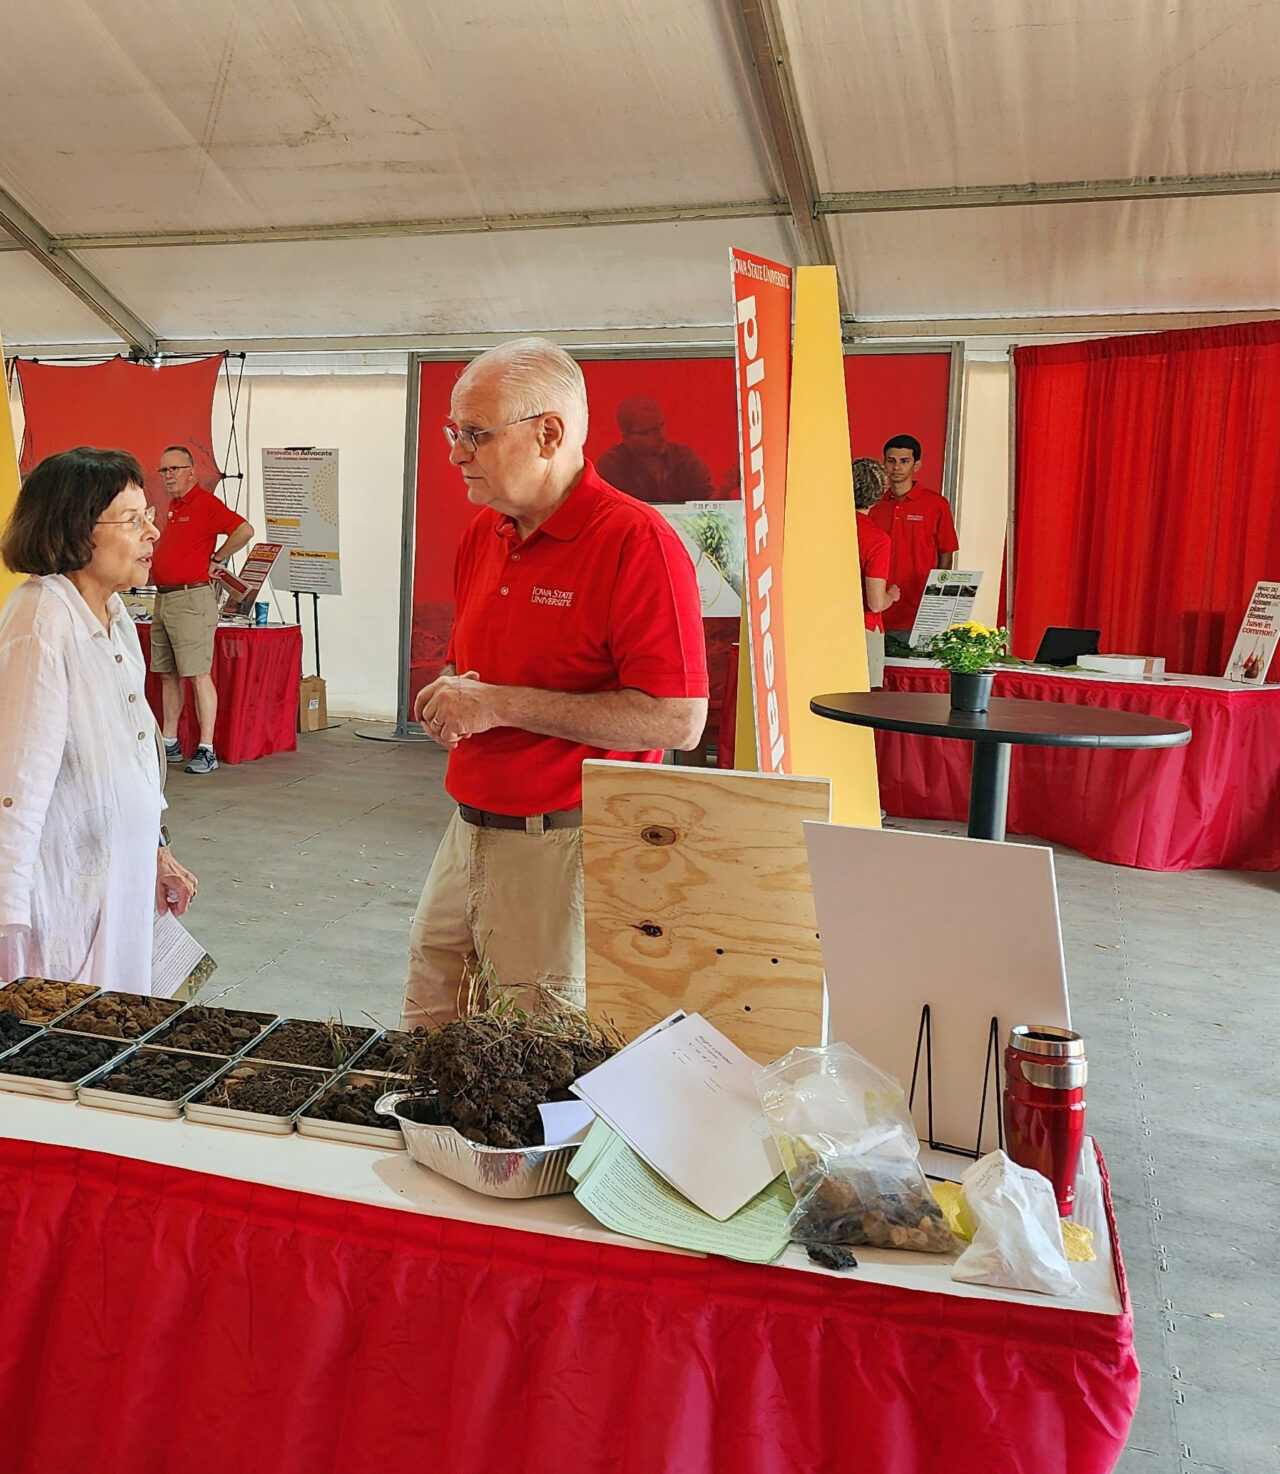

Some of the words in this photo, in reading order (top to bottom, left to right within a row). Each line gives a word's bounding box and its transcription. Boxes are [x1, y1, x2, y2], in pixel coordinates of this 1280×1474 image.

[737, 294, 770, 556] plant
[757, 565, 785, 776] heal
[532, 586, 552, 597] IOWA
[552, 589, 574, 600] STATE
[1246, 619, 1264, 628] have
